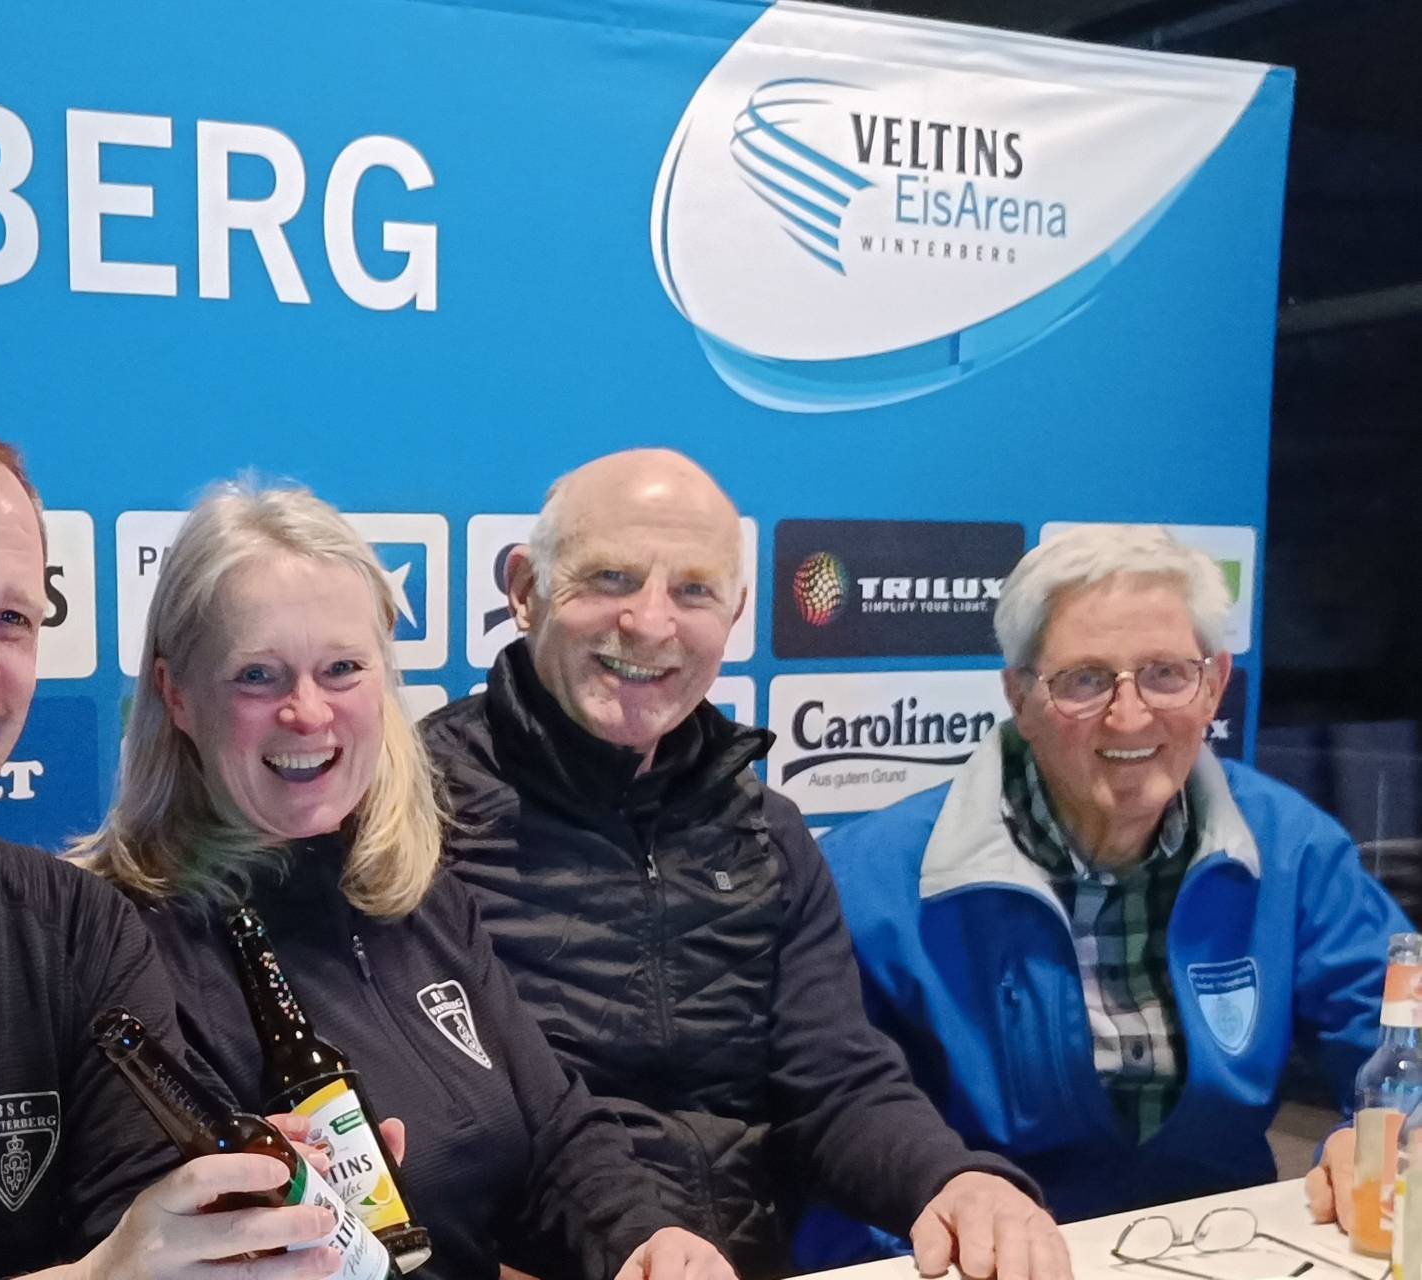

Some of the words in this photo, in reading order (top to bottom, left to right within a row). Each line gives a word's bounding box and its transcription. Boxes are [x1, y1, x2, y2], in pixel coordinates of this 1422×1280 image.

[850, 113, 1024, 180] VELTINS
[895, 173, 1068, 239] EisArena
[860, 235, 1016, 264] WINTERBERG
[857, 576, 1007, 600] TRILUX
[860, 600, 916, 613] SIMPLIFY
[919, 601, 950, 613] YOUR
[808, 772, 831, 787] Aus
[834, 769, 869, 789] gutem
[871, 768, 907, 785] Grund
[327, 1153, 374, 1187] TINS
